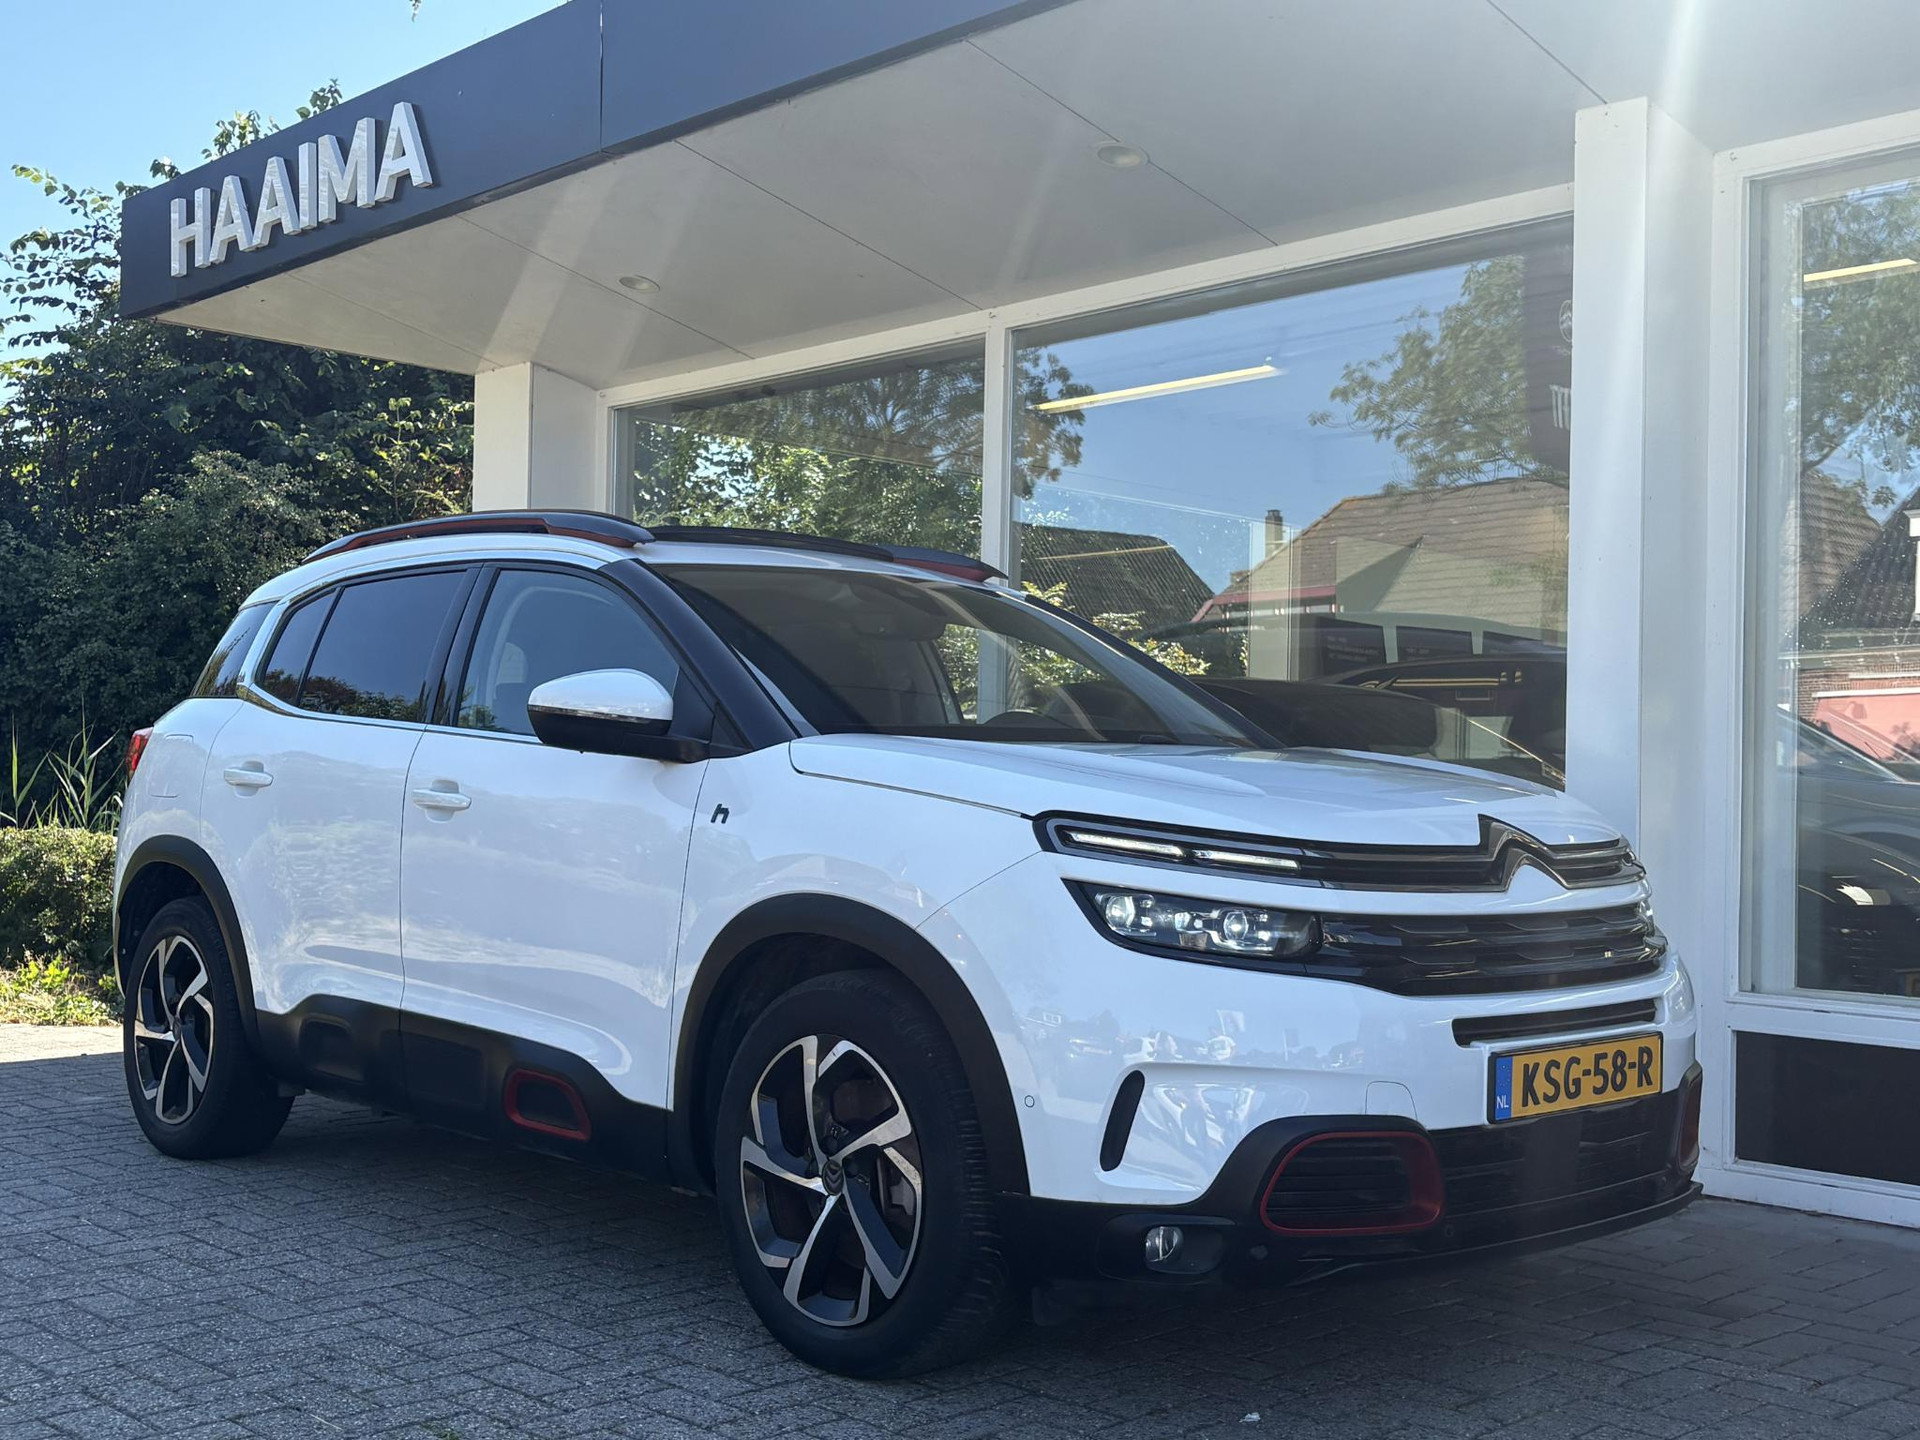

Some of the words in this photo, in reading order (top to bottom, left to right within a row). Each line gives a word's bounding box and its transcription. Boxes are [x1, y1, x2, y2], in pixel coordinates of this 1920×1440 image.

[170, 101, 433, 278] HAAIMA
[1496, 1094, 1509, 1109] NL
[1521, 1045, 1654, 1108] KSG-58-R
